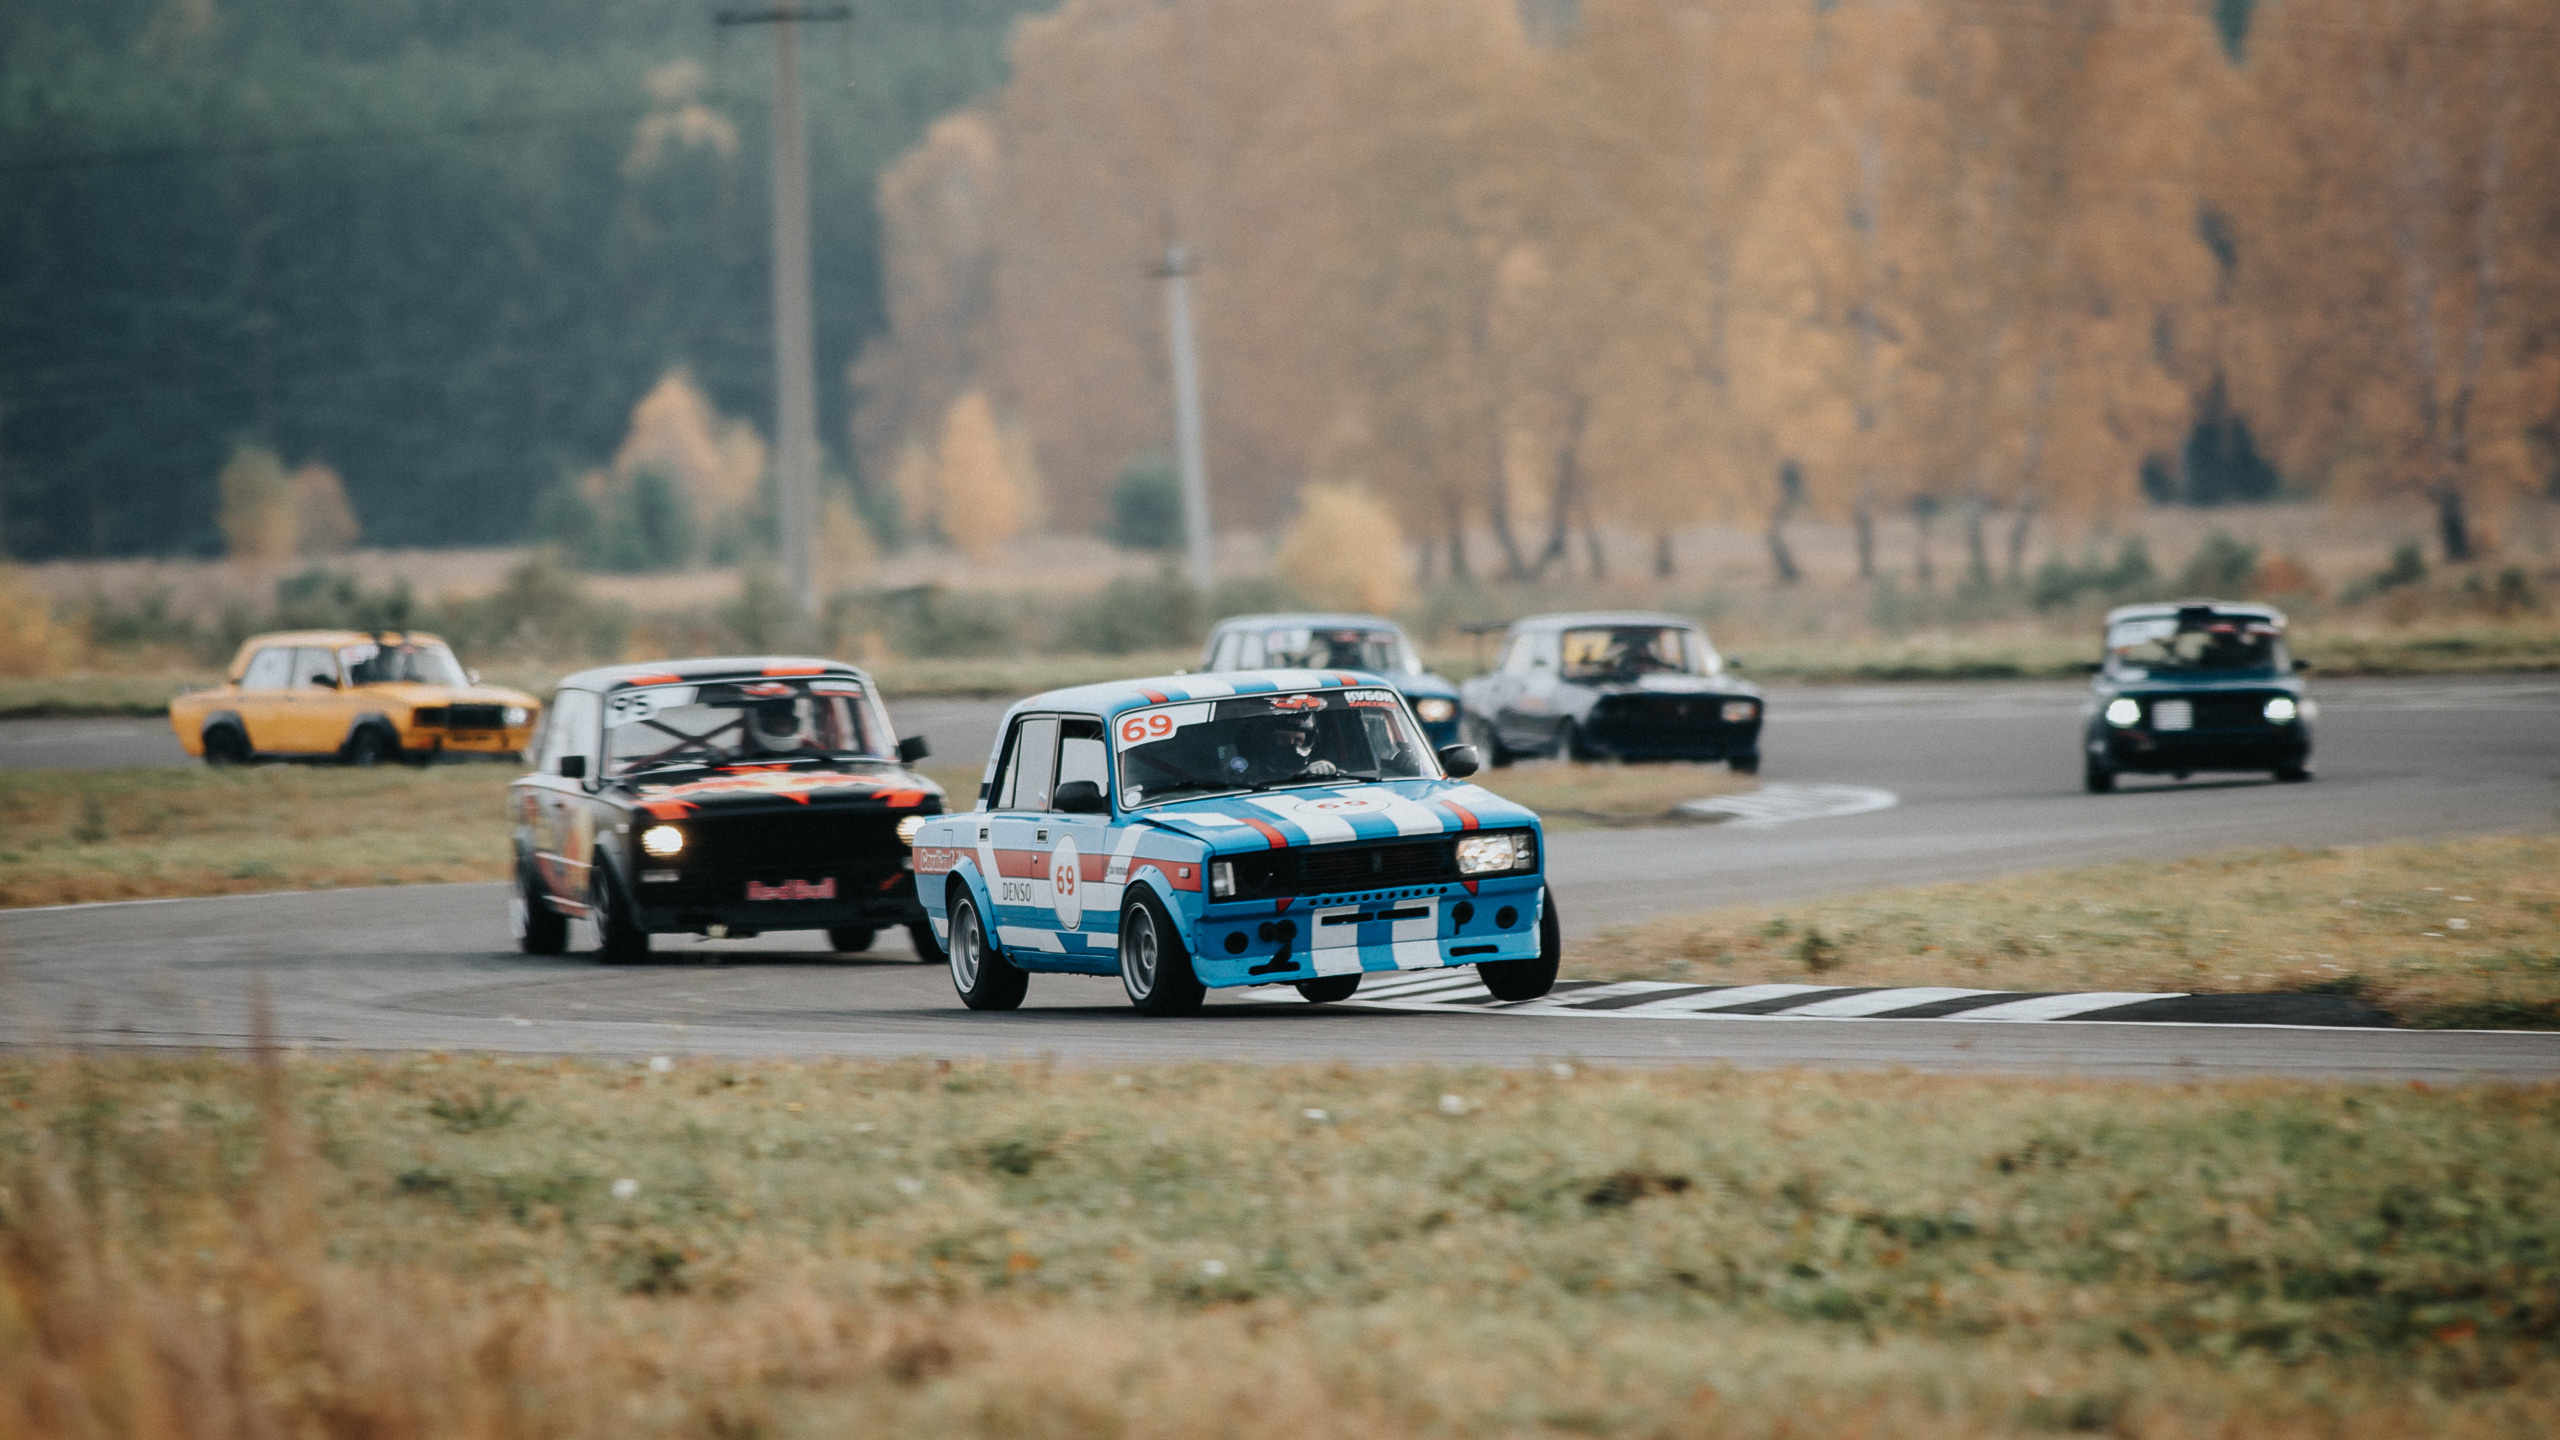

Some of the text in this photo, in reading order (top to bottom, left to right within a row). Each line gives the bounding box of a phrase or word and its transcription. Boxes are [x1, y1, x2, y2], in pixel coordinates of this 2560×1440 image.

[1344, 690, 1395, 702] КУБОК
[1122, 714, 1173, 742] 69
[1317, 801, 1367, 809] 69
[747, 877, 837, 900] Red Bull
[1056, 865, 1075, 896] 69
[1002, 883, 1031, 902] DENSO
